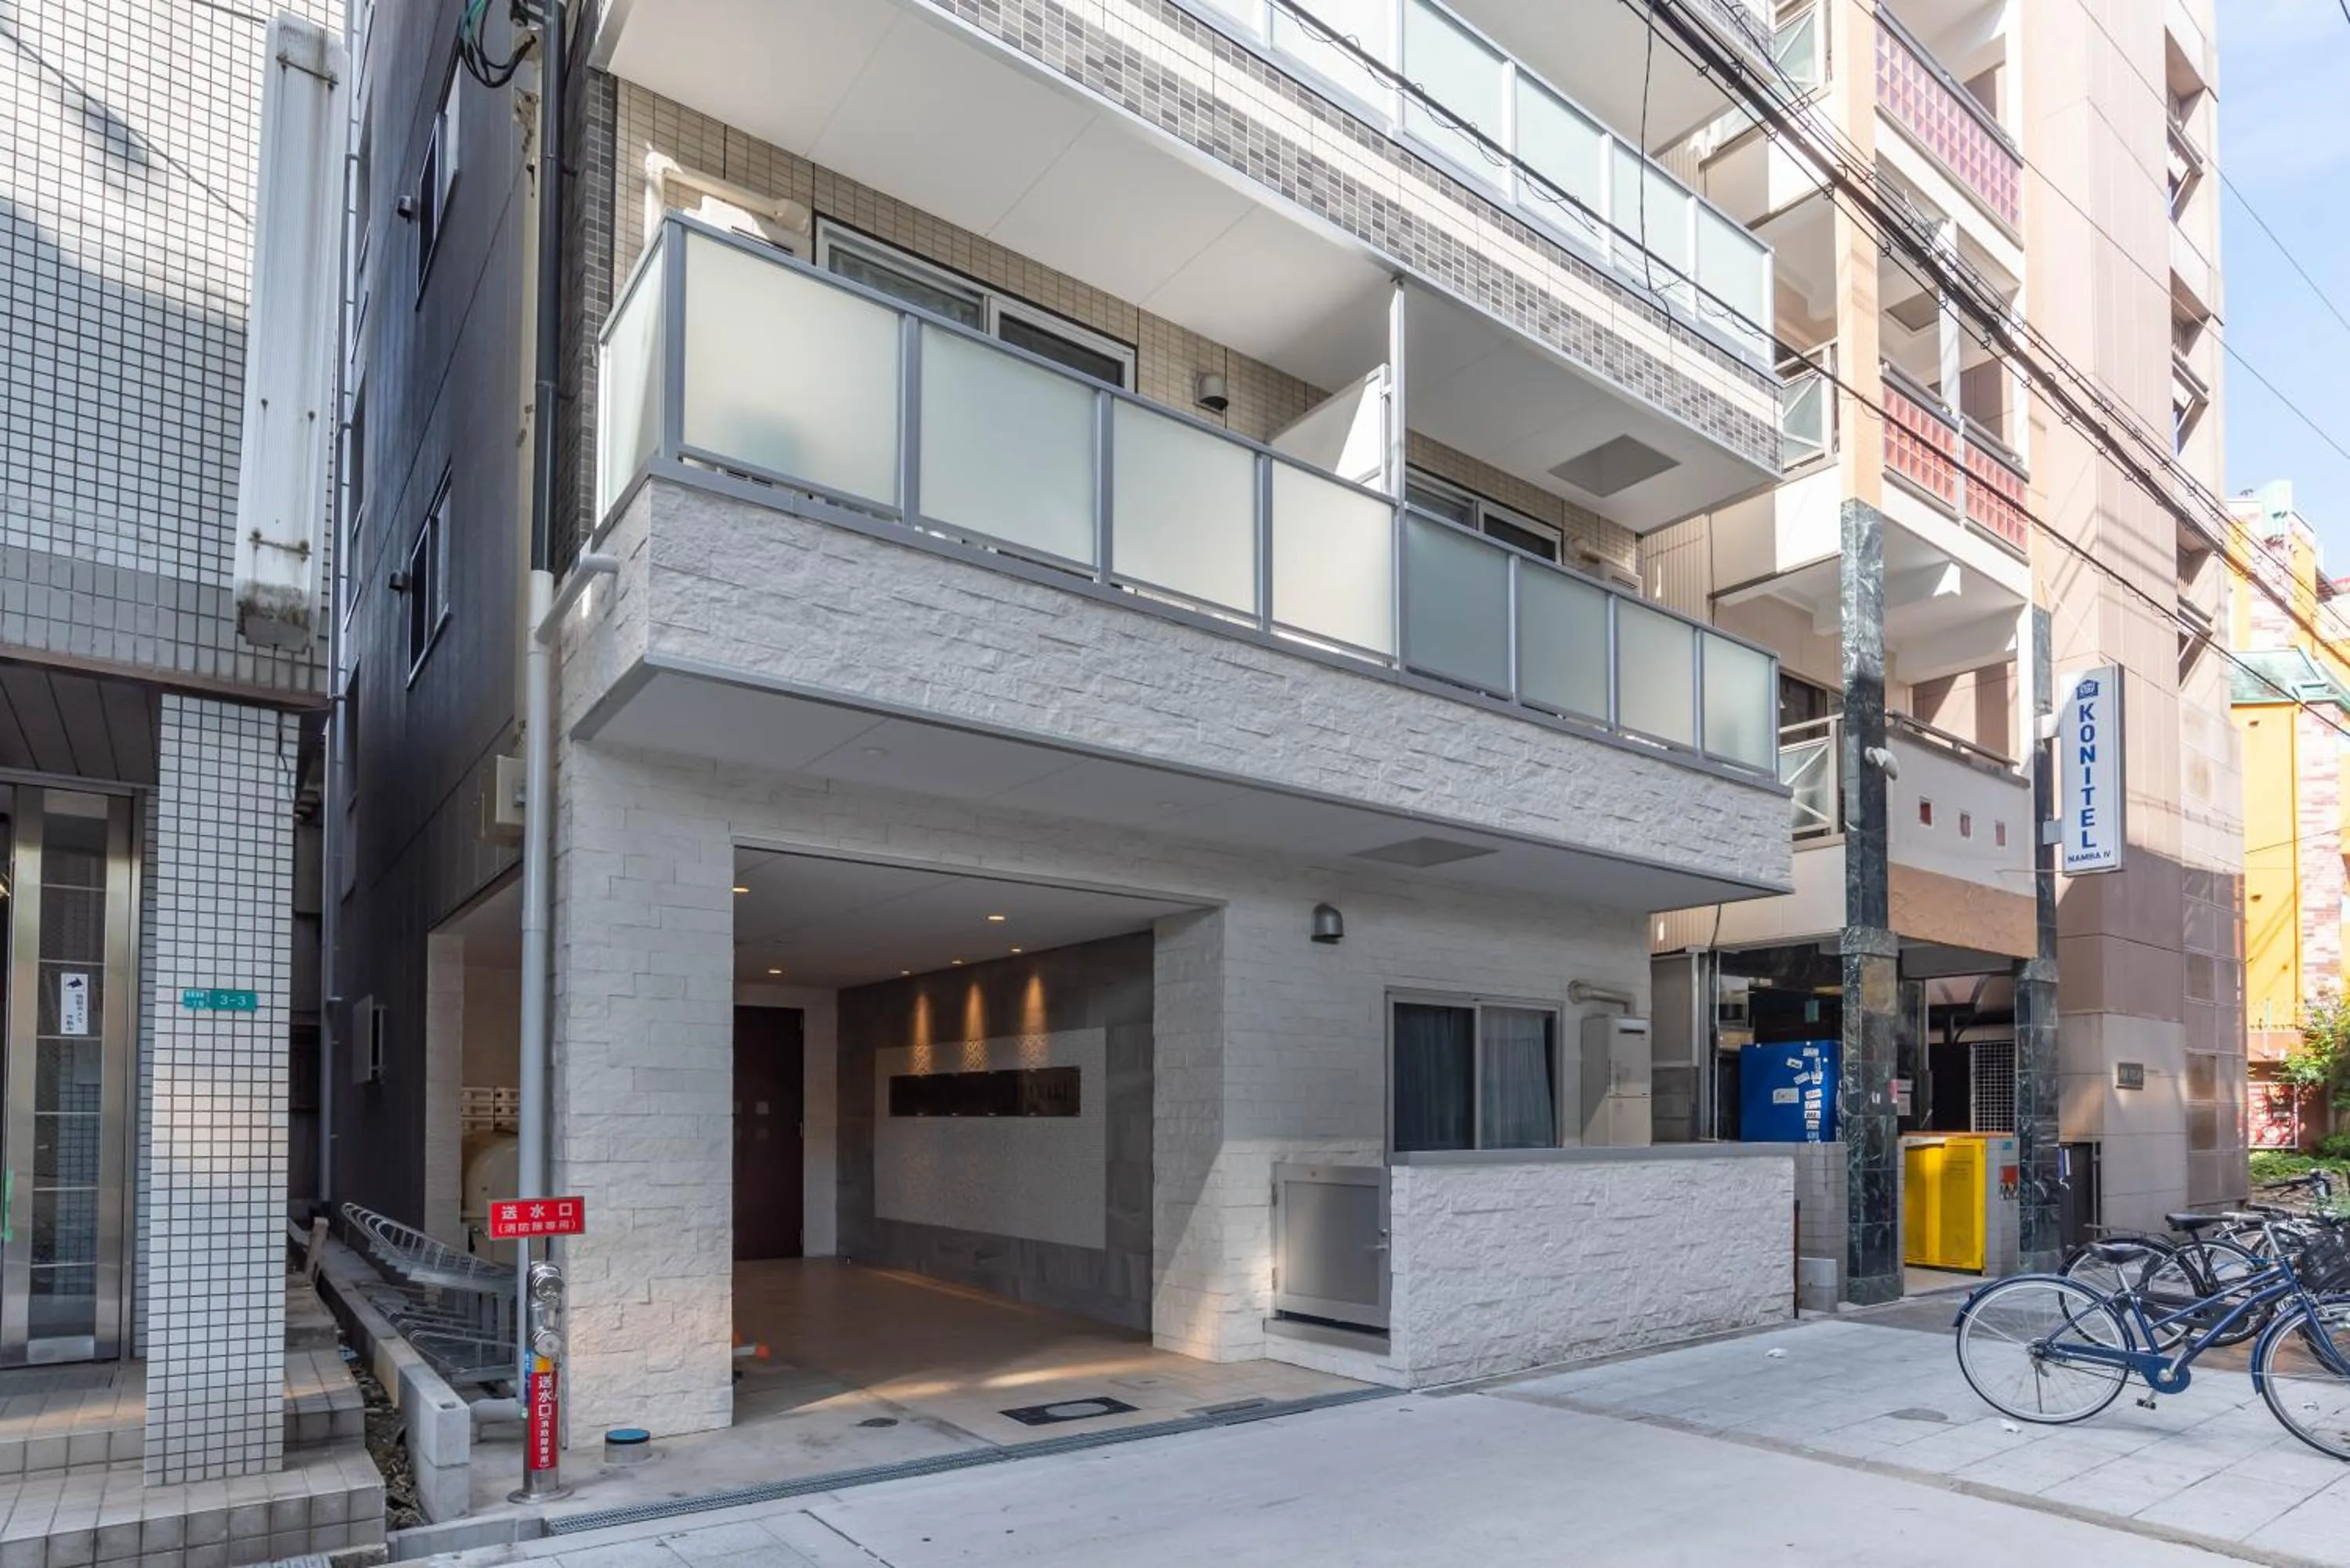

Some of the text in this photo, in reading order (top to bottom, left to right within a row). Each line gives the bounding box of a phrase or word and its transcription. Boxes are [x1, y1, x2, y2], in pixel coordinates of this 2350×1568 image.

[2079, 703, 2096, 848] KONITEL
[220, 994, 247, 1007] 3-3
[502, 1203, 573, 1219] 送水口
